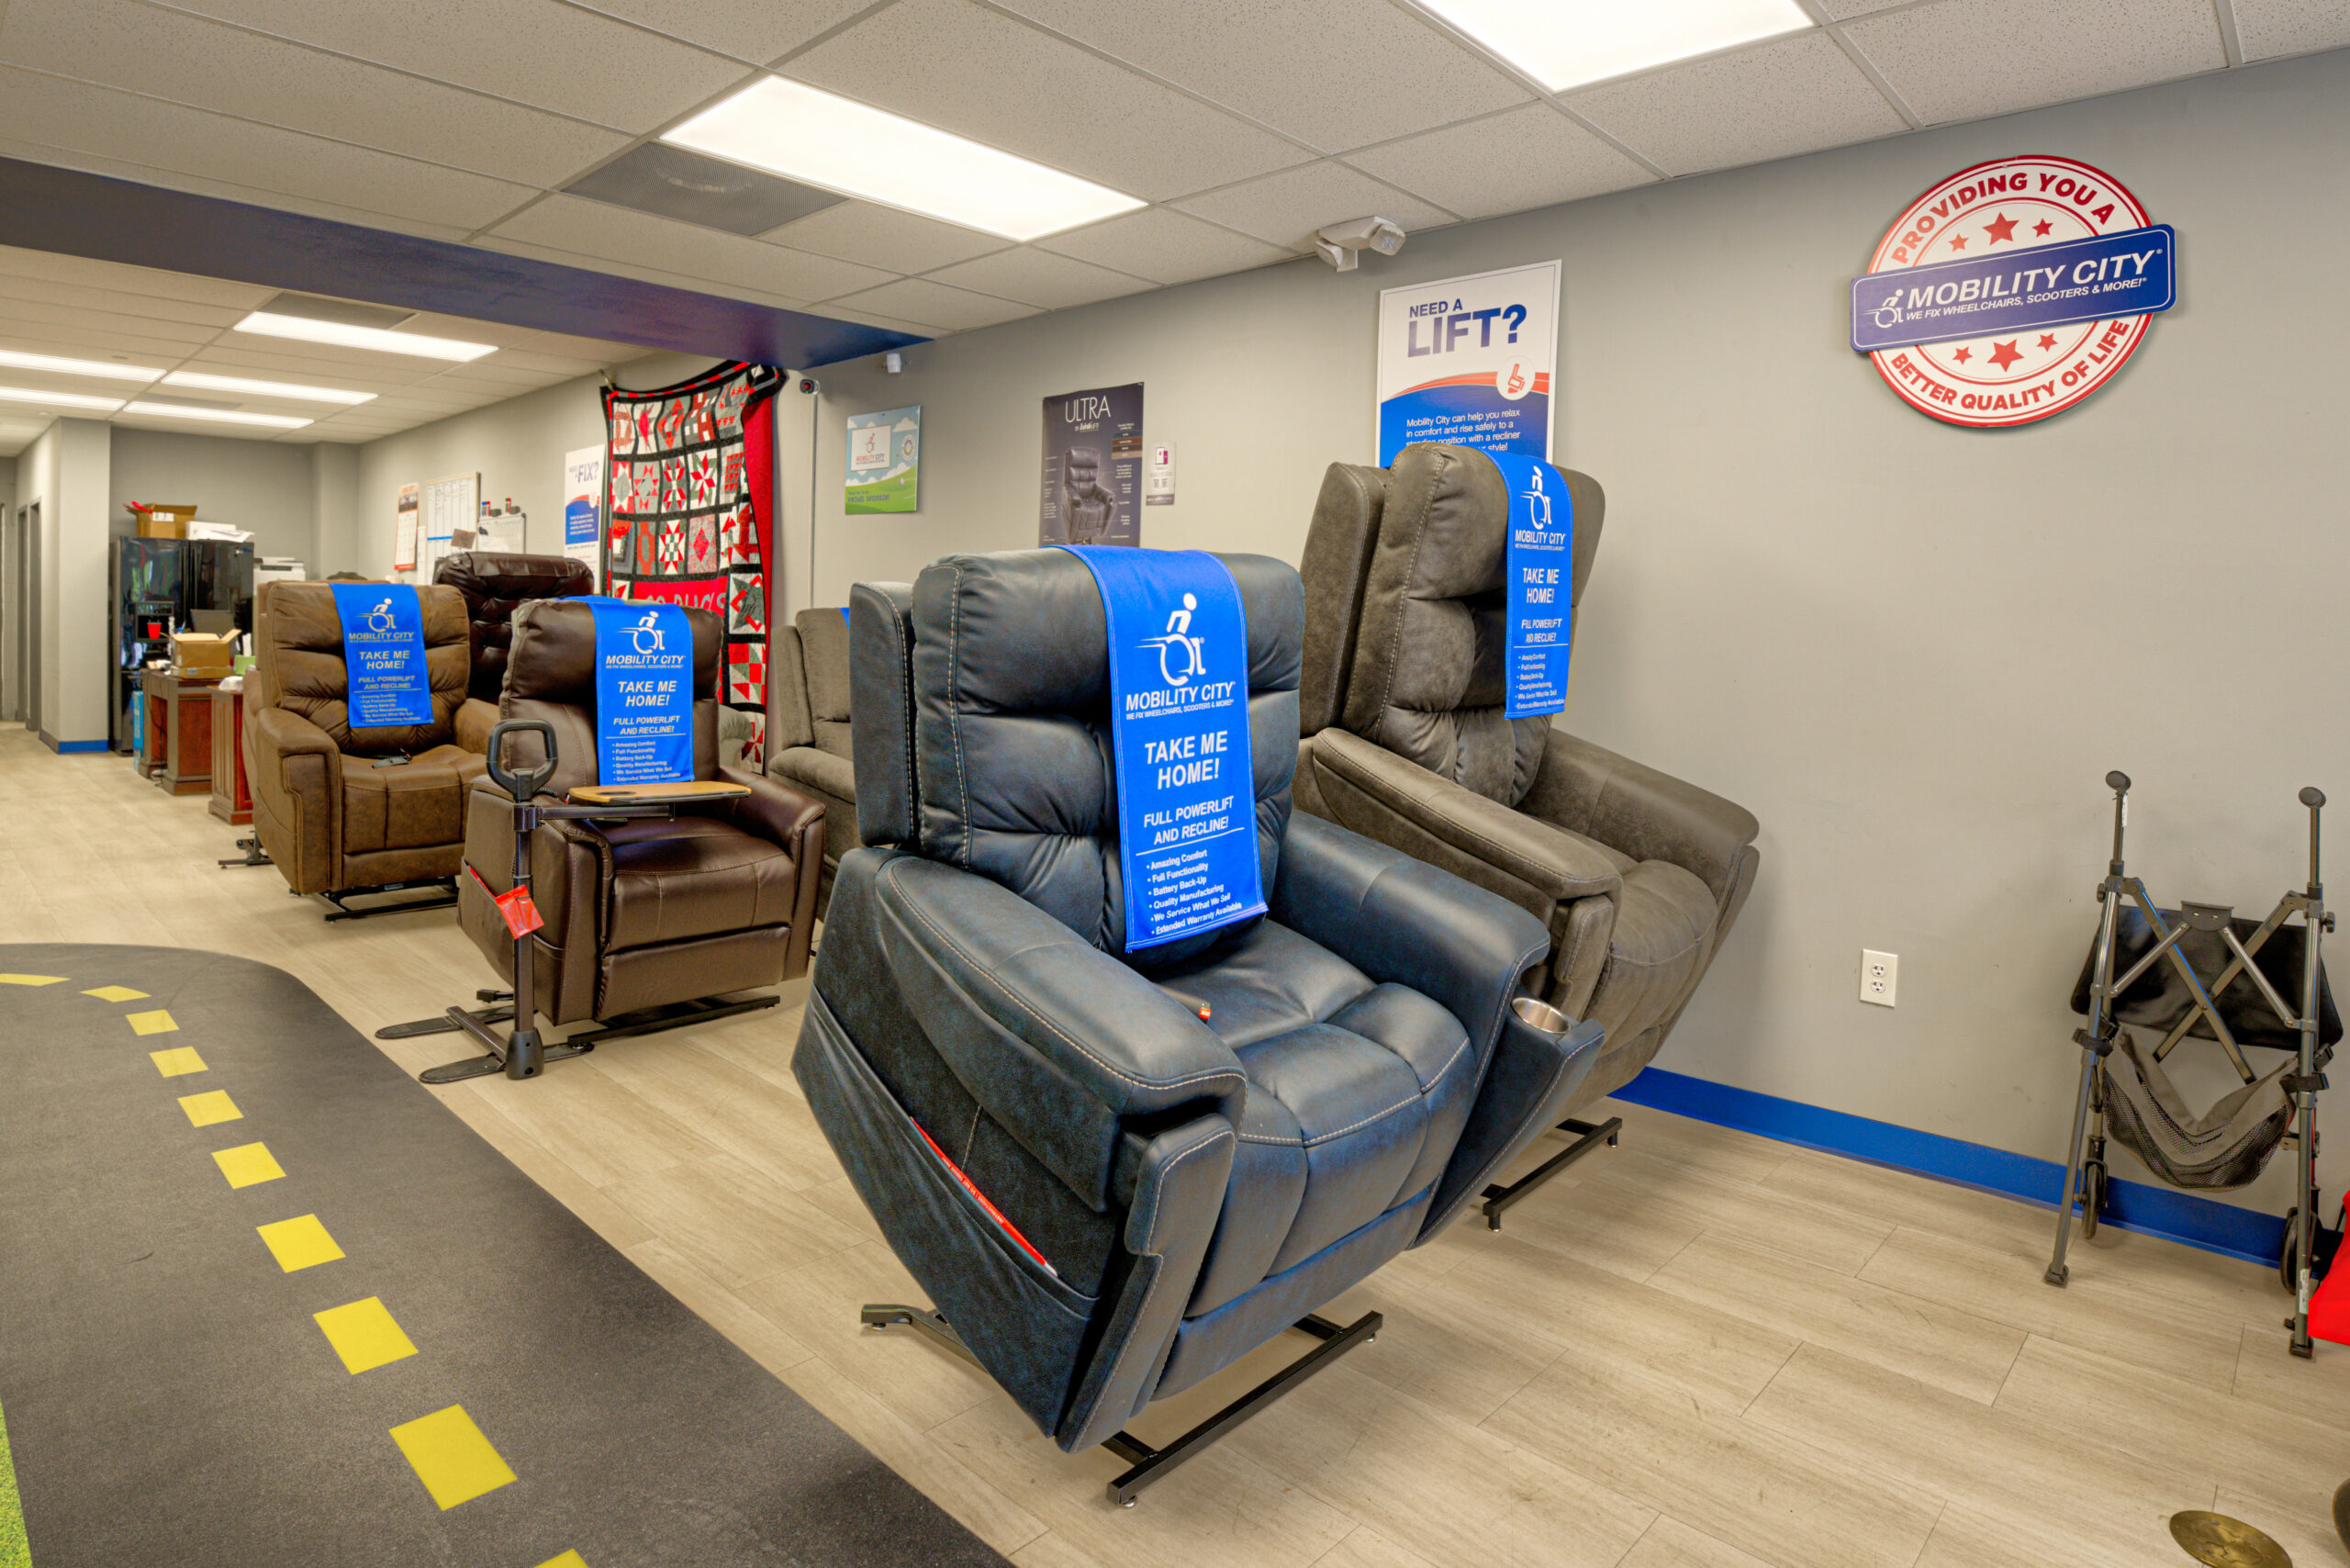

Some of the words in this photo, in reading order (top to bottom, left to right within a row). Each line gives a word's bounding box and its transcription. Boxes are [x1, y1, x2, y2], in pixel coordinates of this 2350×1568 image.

[1890, 172, 2028, 264] PROVIDING
[2039, 173, 2098, 207] YOU
[2091, 203, 2116, 225] A
[1907, 264, 2066, 309] MOBILITY
[1409, 300, 1449, 319] NEED
[1452, 298, 1463, 311] A
[1906, 310, 1923, 321] WE
[1924, 308, 1942, 319] FIX
[1942, 297, 2024, 315] WHEELCHAIRS,
[2026, 286, 2089, 304] SCOOTERS
[2091, 285, 2100, 294] &
[1407, 304, 1528, 357] LIFT?
[1890, 353, 1958, 405] BETTER
[1961, 380, 2057, 411] QUALITY
[2060, 360, 2090, 387] OF
[2087, 319, 2131, 366] LIFE
[1065, 395, 1111, 423] ULTRA
[1406, 418, 1434, 427] Mobility
[1435, 415, 1450, 425] City
[1451, 414, 1466, 422] can
[1467, 412, 1483, 421] help
[1485, 410, 1500, 420] you
[1501, 409, 1521, 418] relax
[1405, 430, 1413, 438] in
[1414, 427, 1442, 437] comfort
[1444, 425, 1458, 434] and
[1460, 424, 1473, 432] rise
[1474, 421, 1496, 432] safely
[1498, 420, 1506, 429] to
[1468, 433, 1483, 442] with
[1492, 431, 1520, 441] recliner
[577, 461, 599, 483] FIX?
[1515, 529, 1548, 543] MOBILITY
[1550, 532, 1565, 544] CITY
[1523, 567, 1544, 584] TAKE
[1547, 568, 1560, 584] ME
[1527, 588, 1554, 603] HOME!
[349, 632, 392, 640] MOBILITY
[359, 650, 389, 660] TAKE
[393, 650, 410, 658] ME
[366, 660, 405, 669] HOME!
[606, 655, 659, 665] MOBILITY
[661, 655, 684, 665] CITY
[618, 680, 655, 693] TAKE
[657, 680, 677, 692] ME
[1125, 686, 1199, 711] MOBILITY
[1202, 681, 1234, 700] CITY
[625, 694, 670, 707] HOME!
[1183, 702, 1210, 712] SCOOTERS
[636, 715, 680, 724] POWERLIFT
[620, 727, 637, 735] AND
[639, 725, 675, 734] RECLINE!
[1145, 736, 1195, 765] TAKE
[1201, 730, 1228, 755] ME
[1158, 757, 1220, 790] HOME!
[1144, 810, 1172, 828] FULL
[1175, 795, 1234, 821] POWERLIFT
[1154, 828, 1179, 845] AND
[1181, 815, 1228, 840] RECLINE!
[1151, 857, 1181, 870] Amazing
[1181, 849, 1207, 862] Comfort
[1152, 872, 1165, 882] Full
[1167, 863, 1208, 879] Functionality
[1153, 884, 1178, 896] Battery
[1180, 876, 1206, 890] Back-Up
[1154, 897, 1178, 909] Quality
[1180, 884, 1224, 902] Manufacturing
[1154, 913, 1165, 922] We
[1167, 906, 1191, 918] Service
[1192, 901, 1210, 912] What
[1211, 897, 1220, 905] We
[1220, 892, 1231, 902] Sell
[1156, 919, 1186, 935] Extended
[1187, 912, 1214, 925] Warranty
[1215, 902, 1242, 916] Available
